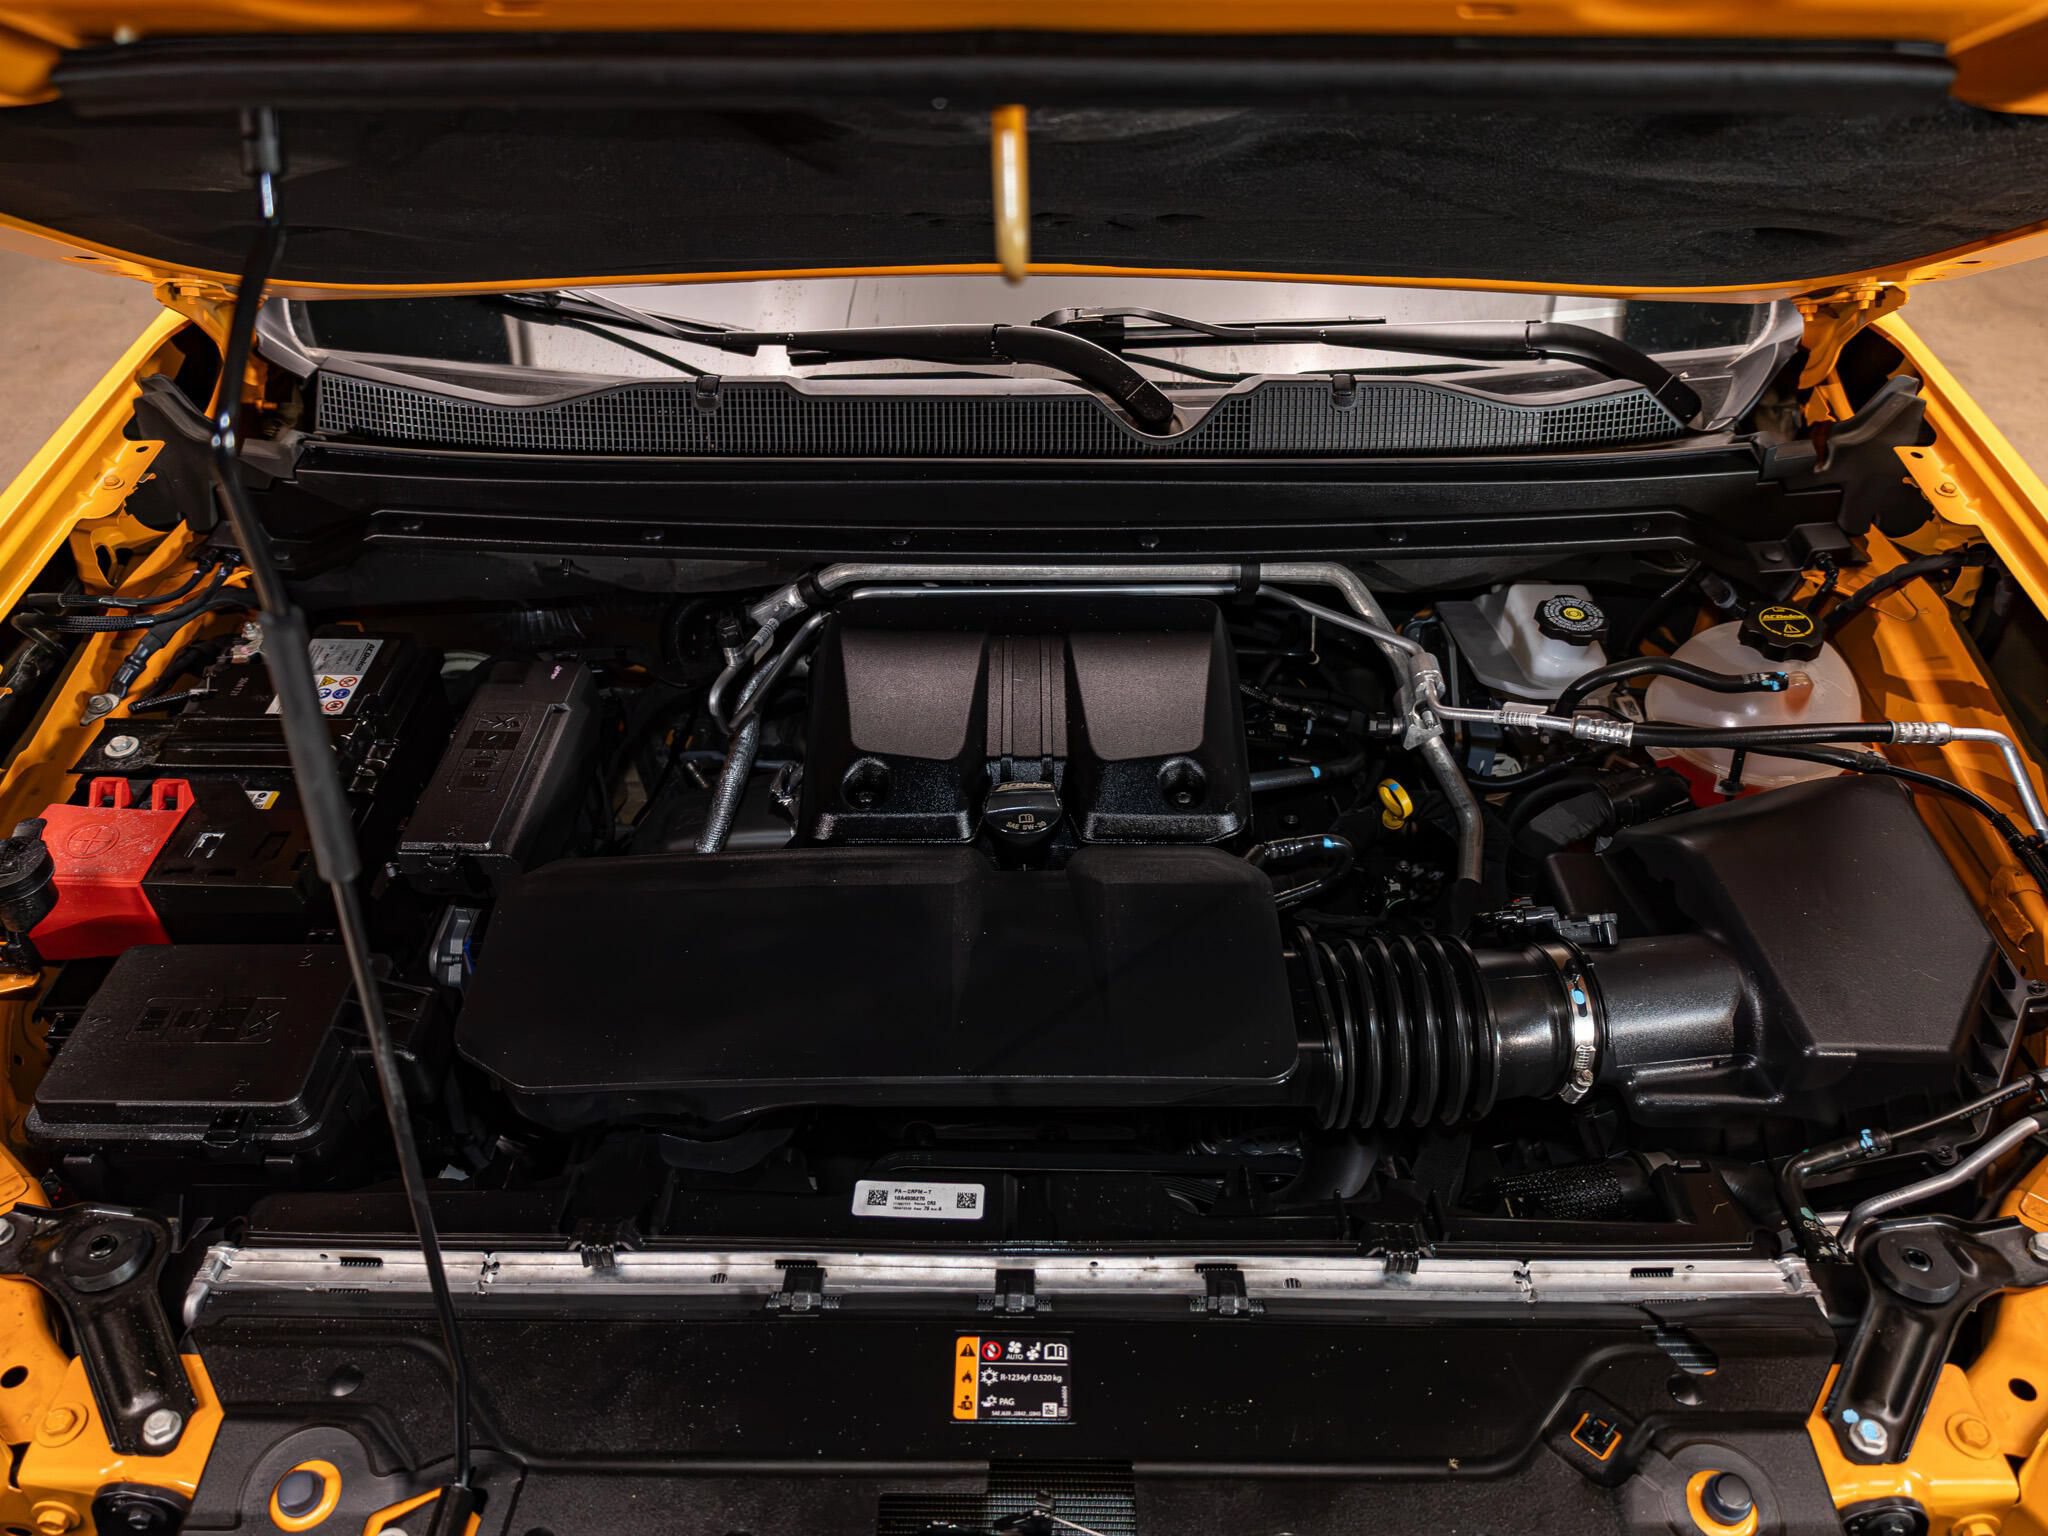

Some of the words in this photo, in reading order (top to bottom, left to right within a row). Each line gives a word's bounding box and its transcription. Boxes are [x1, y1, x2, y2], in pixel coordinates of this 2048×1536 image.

[997, 782, 1052, 791] ACDelco
[1006, 821, 1020, 830] SAE
[1000, 1373, 1031, 1383] R-1234yf
[1032, 1373, 1052, 1382] 0.520
[1052, 1373, 1063, 1383] kg
[999, 1398, 1015, 1406] PAG
